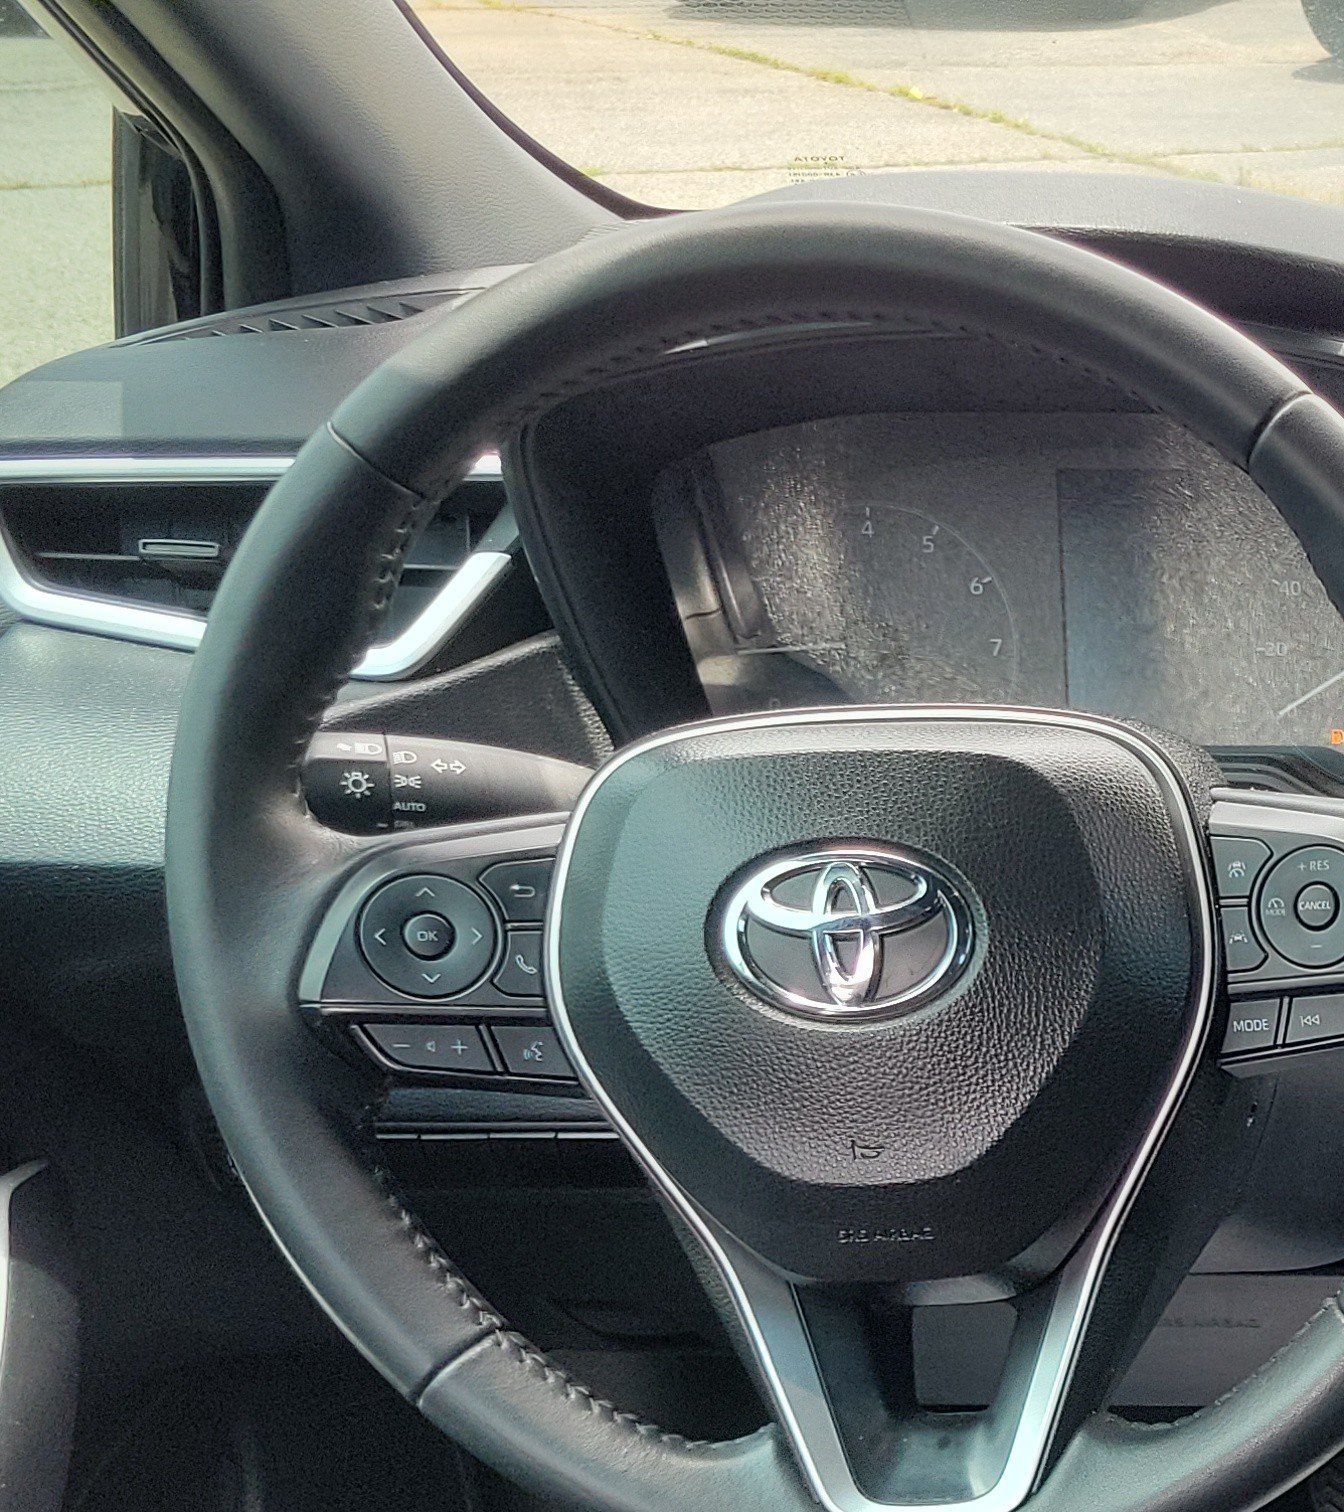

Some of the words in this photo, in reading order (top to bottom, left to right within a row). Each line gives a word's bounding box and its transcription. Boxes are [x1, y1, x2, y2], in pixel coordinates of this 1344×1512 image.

[861, 521, 875, 538] 4
[922, 535, 935, 553] 5
[969, 576, 984, 595] 6
[1279, 580, 1301, 597] 40
[989, 638, 1003, 657] 7
[392, 801, 427, 813] AUTO
[1309, 860, 1331, 871] RES
[1266, 907, 1286, 917] MODE
[1299, 900, 1332, 911] CANCEL
[416, 930, 439, 942] OK
[1233, 1018, 1270, 1033] MODE
